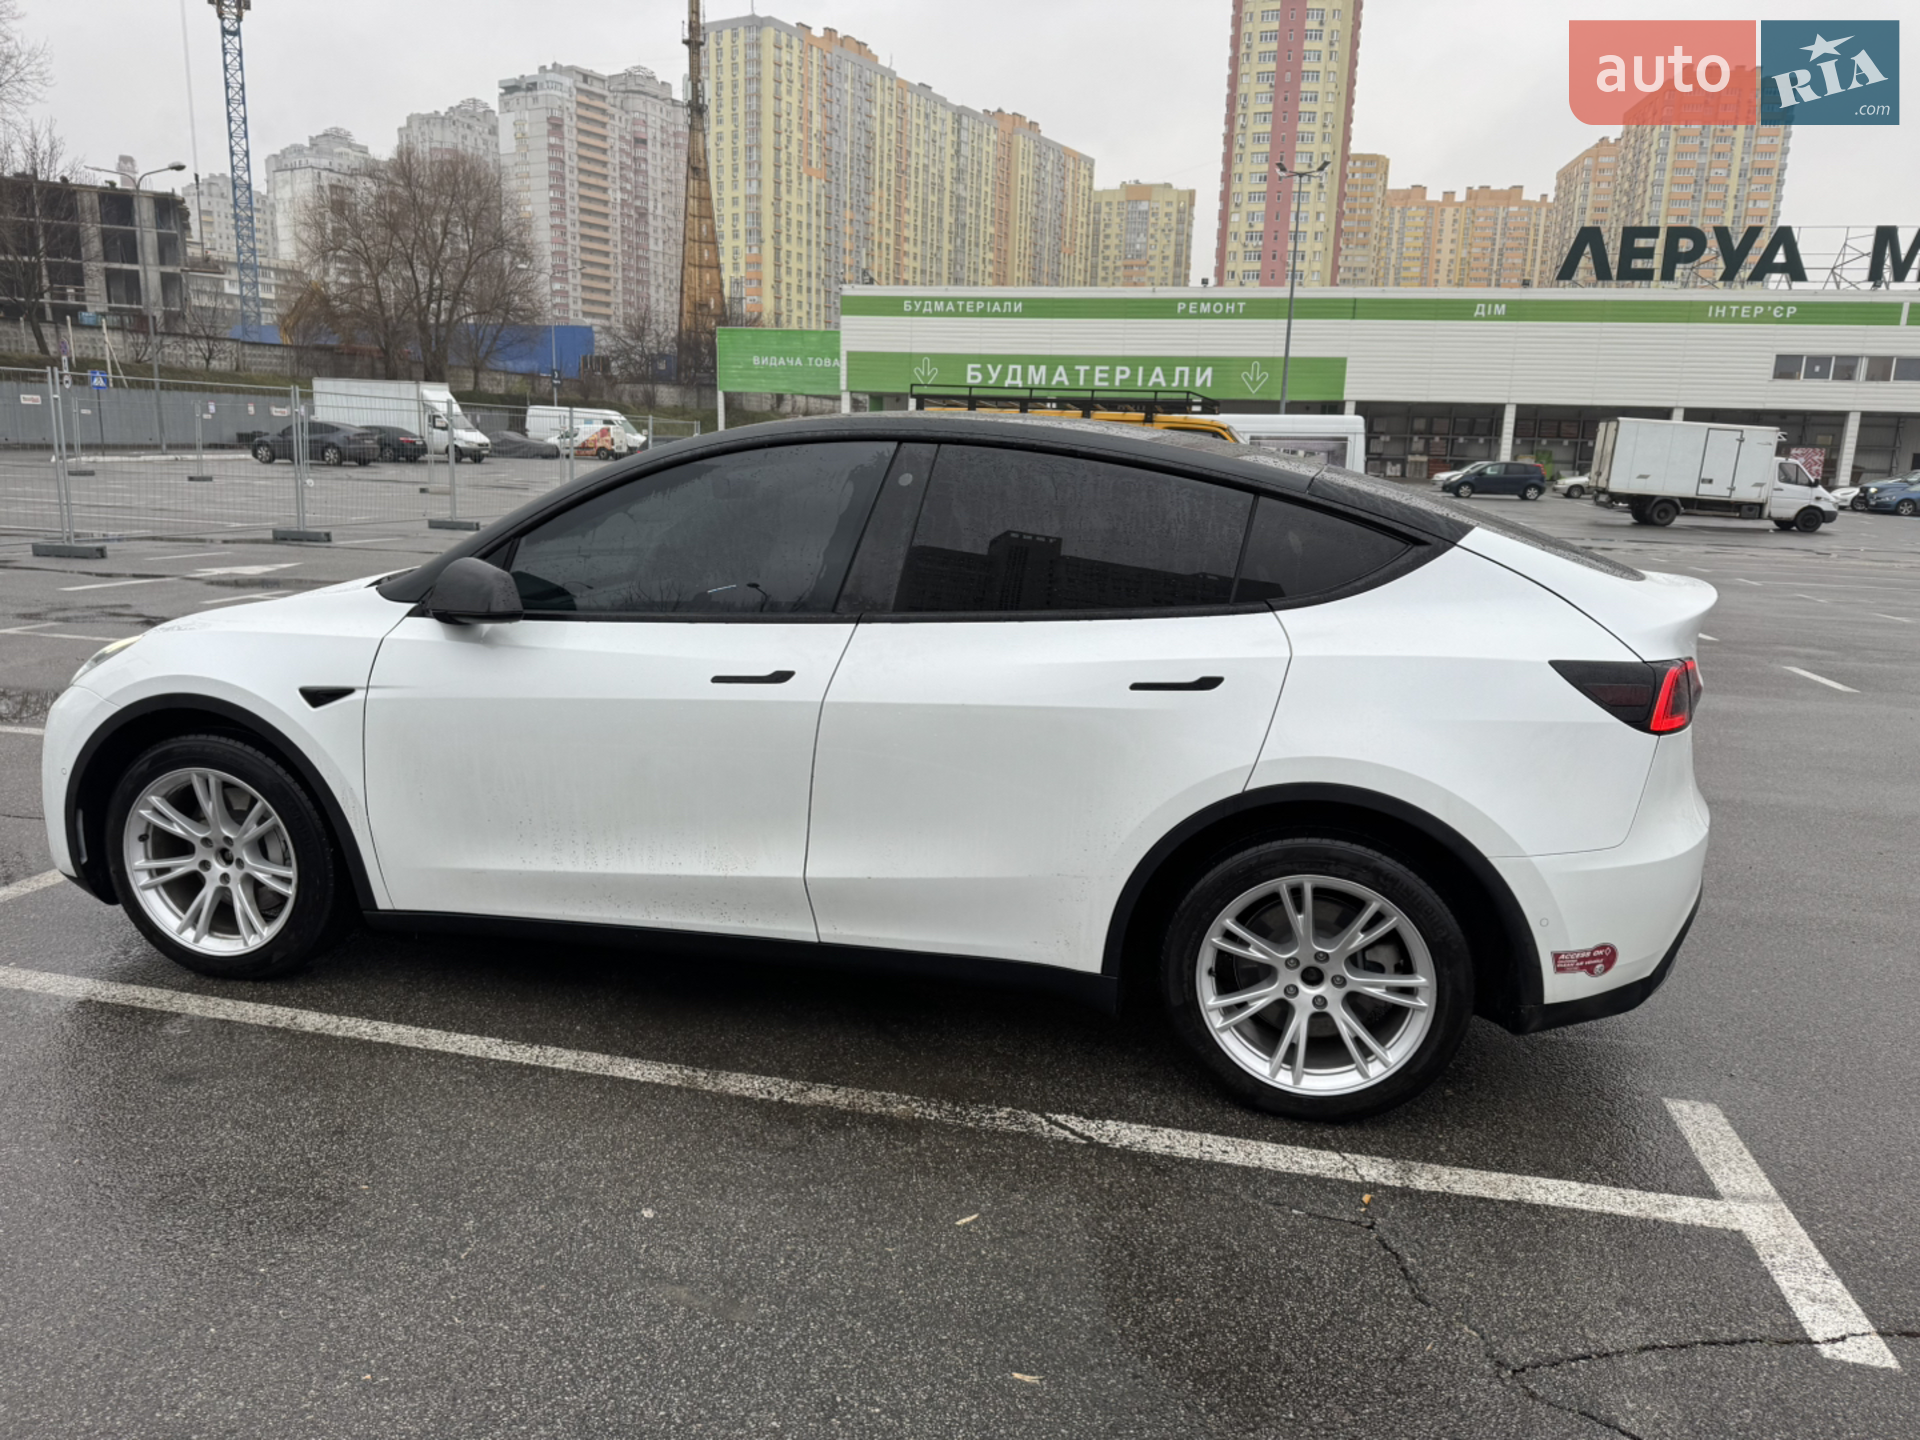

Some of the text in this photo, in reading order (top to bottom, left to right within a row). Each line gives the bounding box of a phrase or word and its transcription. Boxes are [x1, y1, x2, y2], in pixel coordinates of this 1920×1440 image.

[1555, 225, 1809, 282] ЛЕРУА
[903, 300, 1023, 314] БУДМАТЕРІАЛИ
[1177, 302, 1246, 314] РЕМОНТ
[1473, 303, 1507, 318] ДІМ
[752, 355, 840, 368] ВИДАЧА ТОВА
[966, 363, 1213, 388] БУДМАТЕРІАЛИ
